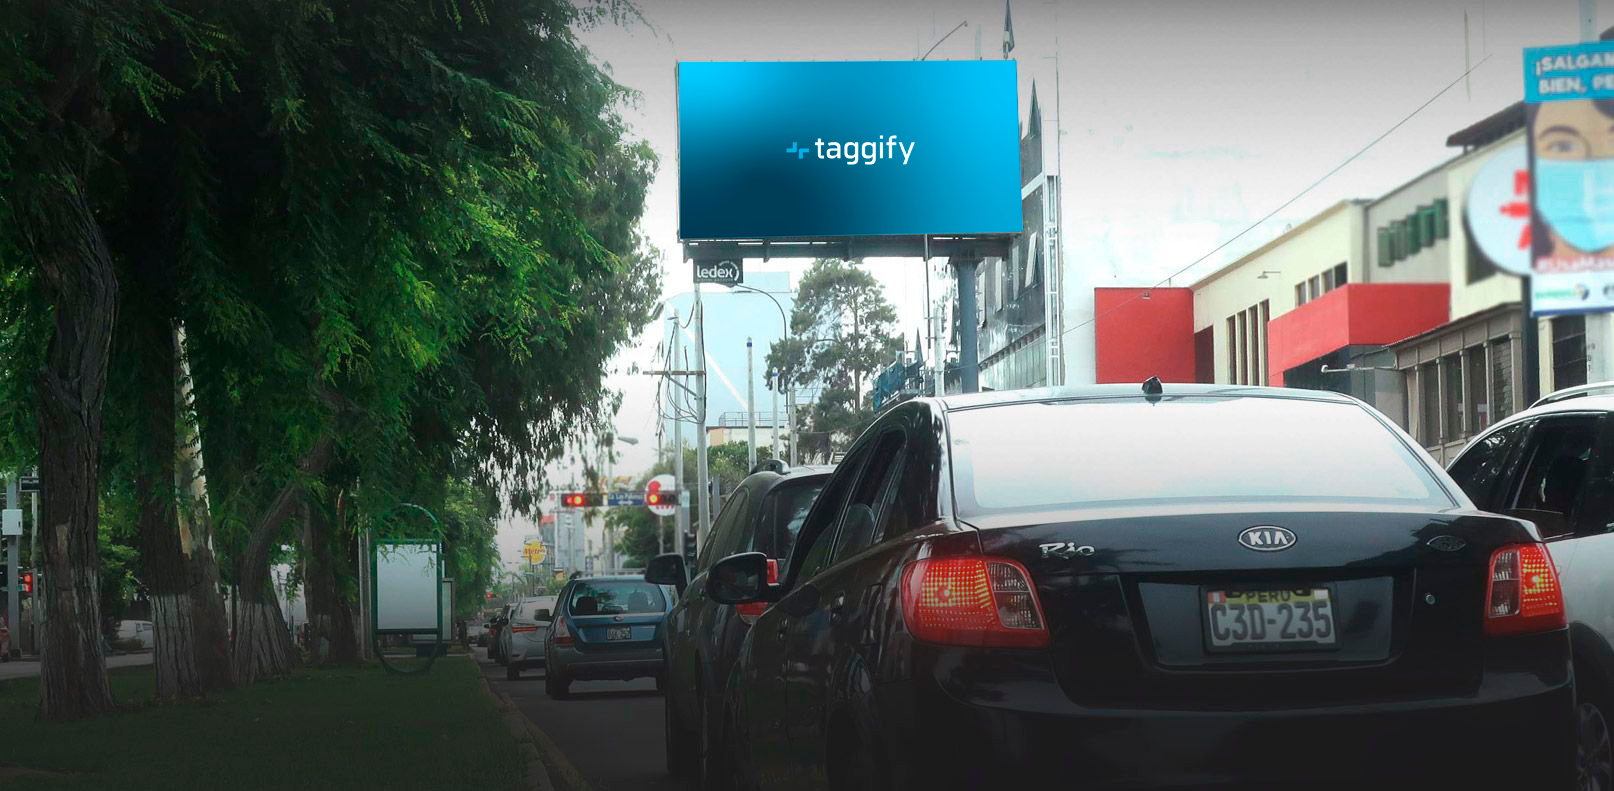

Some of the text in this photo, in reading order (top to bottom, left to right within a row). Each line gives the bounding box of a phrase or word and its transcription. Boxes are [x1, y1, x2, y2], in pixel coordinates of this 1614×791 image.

[1539, 76, 1588, 94] BIEN,
[815, 135, 915, 165] taggify
[696, 265, 733, 278] ledex
[1248, 531, 1288, 545] KIA
[1039, 542, 1095, 559] Rio
[1210, 601, 1331, 641] C3D-235
